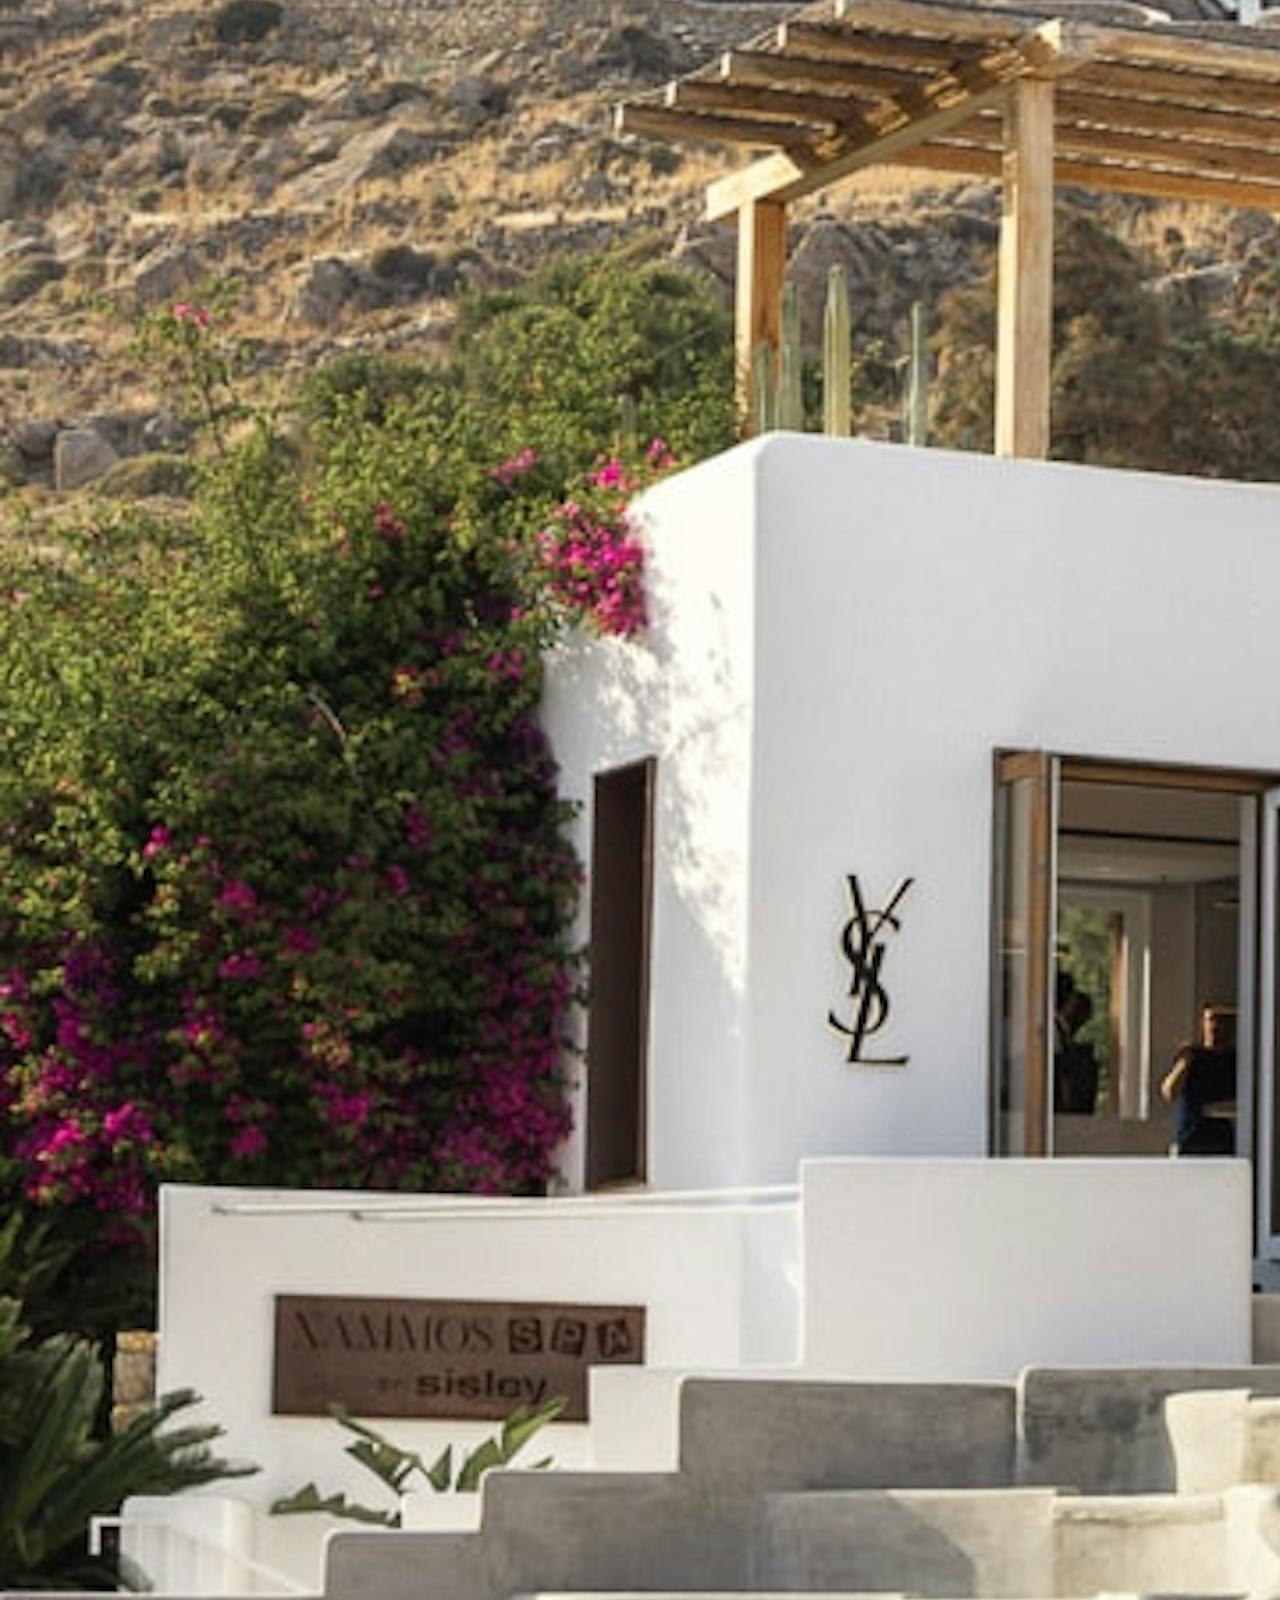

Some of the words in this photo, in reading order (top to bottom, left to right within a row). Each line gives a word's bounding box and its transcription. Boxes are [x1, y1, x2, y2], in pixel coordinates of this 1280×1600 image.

[828, 874, 914, 1065] YSL
[293, 1310, 494, 1352] NAMMOS
[508, 1316, 633, 1357] SPA
[416, 1368, 548, 1404] sisley
